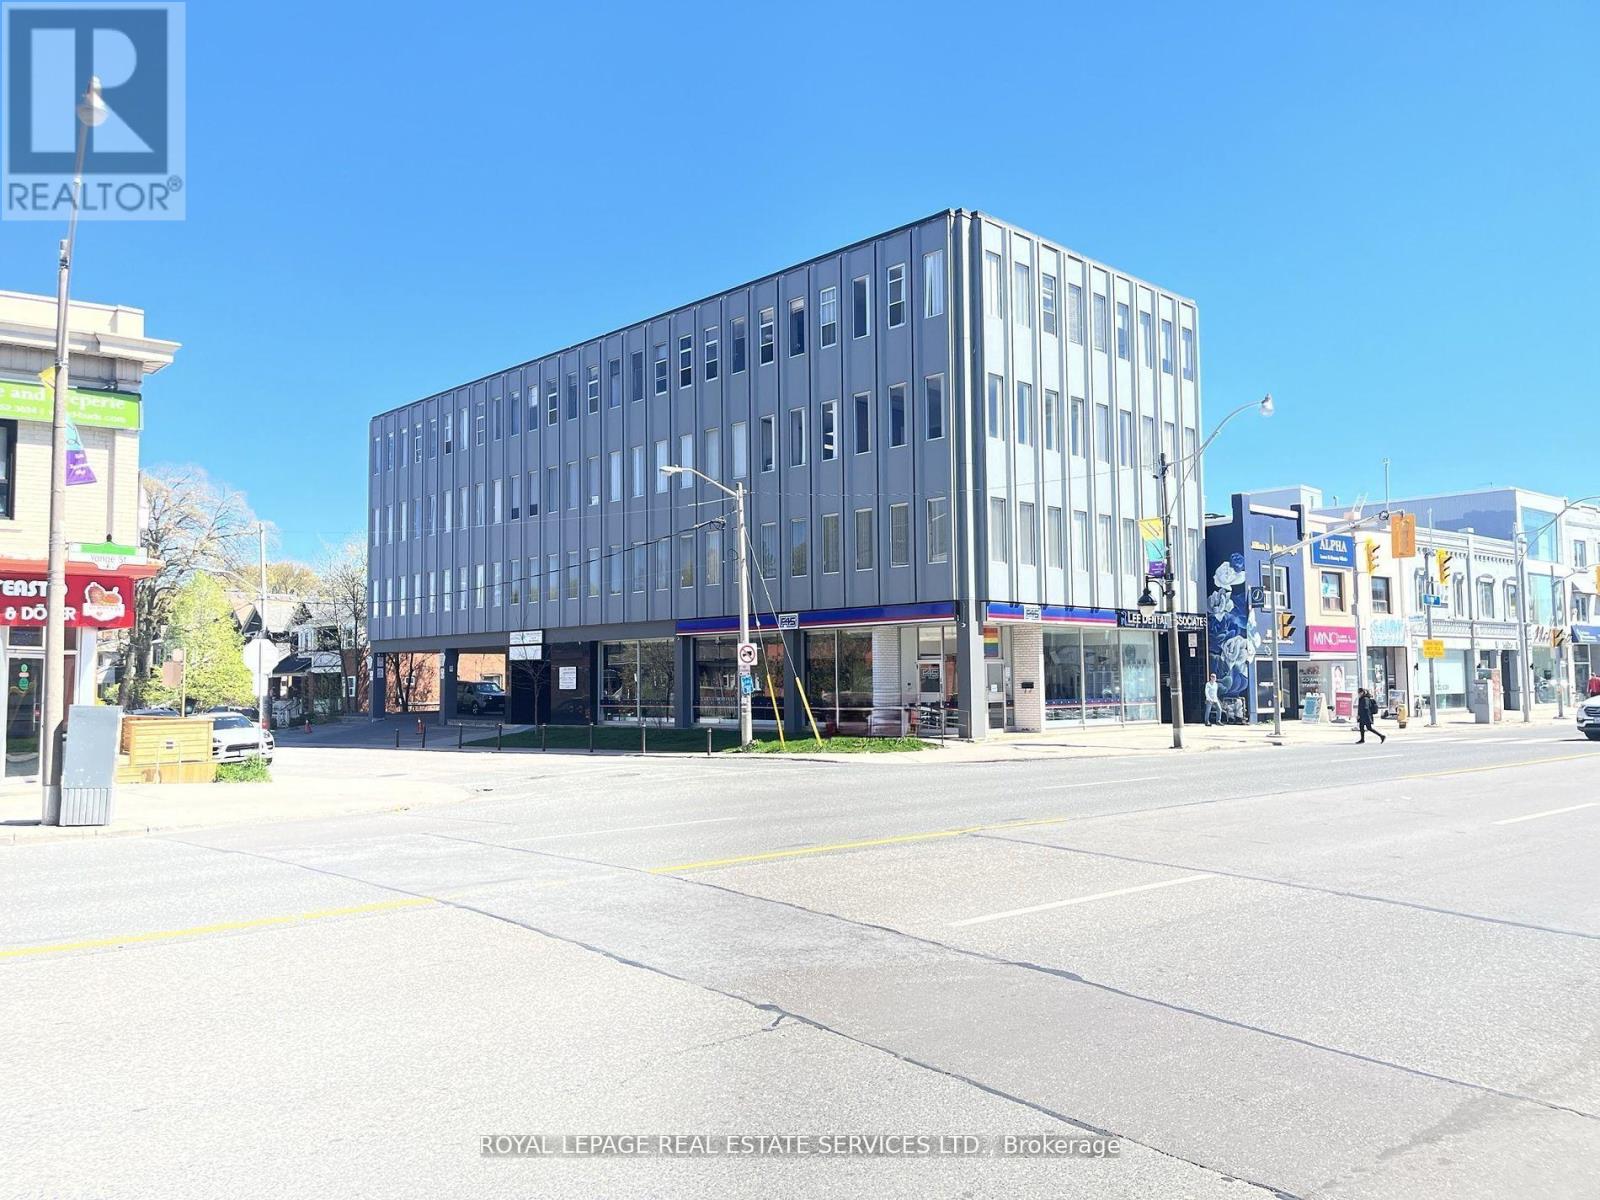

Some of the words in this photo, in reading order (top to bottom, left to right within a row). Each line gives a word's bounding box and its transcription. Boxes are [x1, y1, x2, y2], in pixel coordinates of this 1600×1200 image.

[10, 387, 45, 400] and
[1319, 539, 1347, 553] ALPHA
[5, 606, 16, 620] &
[21, 603, 76, 621] DÖER
[1127, 611, 1141, 624] LEE
[1177, 614, 1207, 627] SSOCIATES
[780, 616, 796, 627] F45
